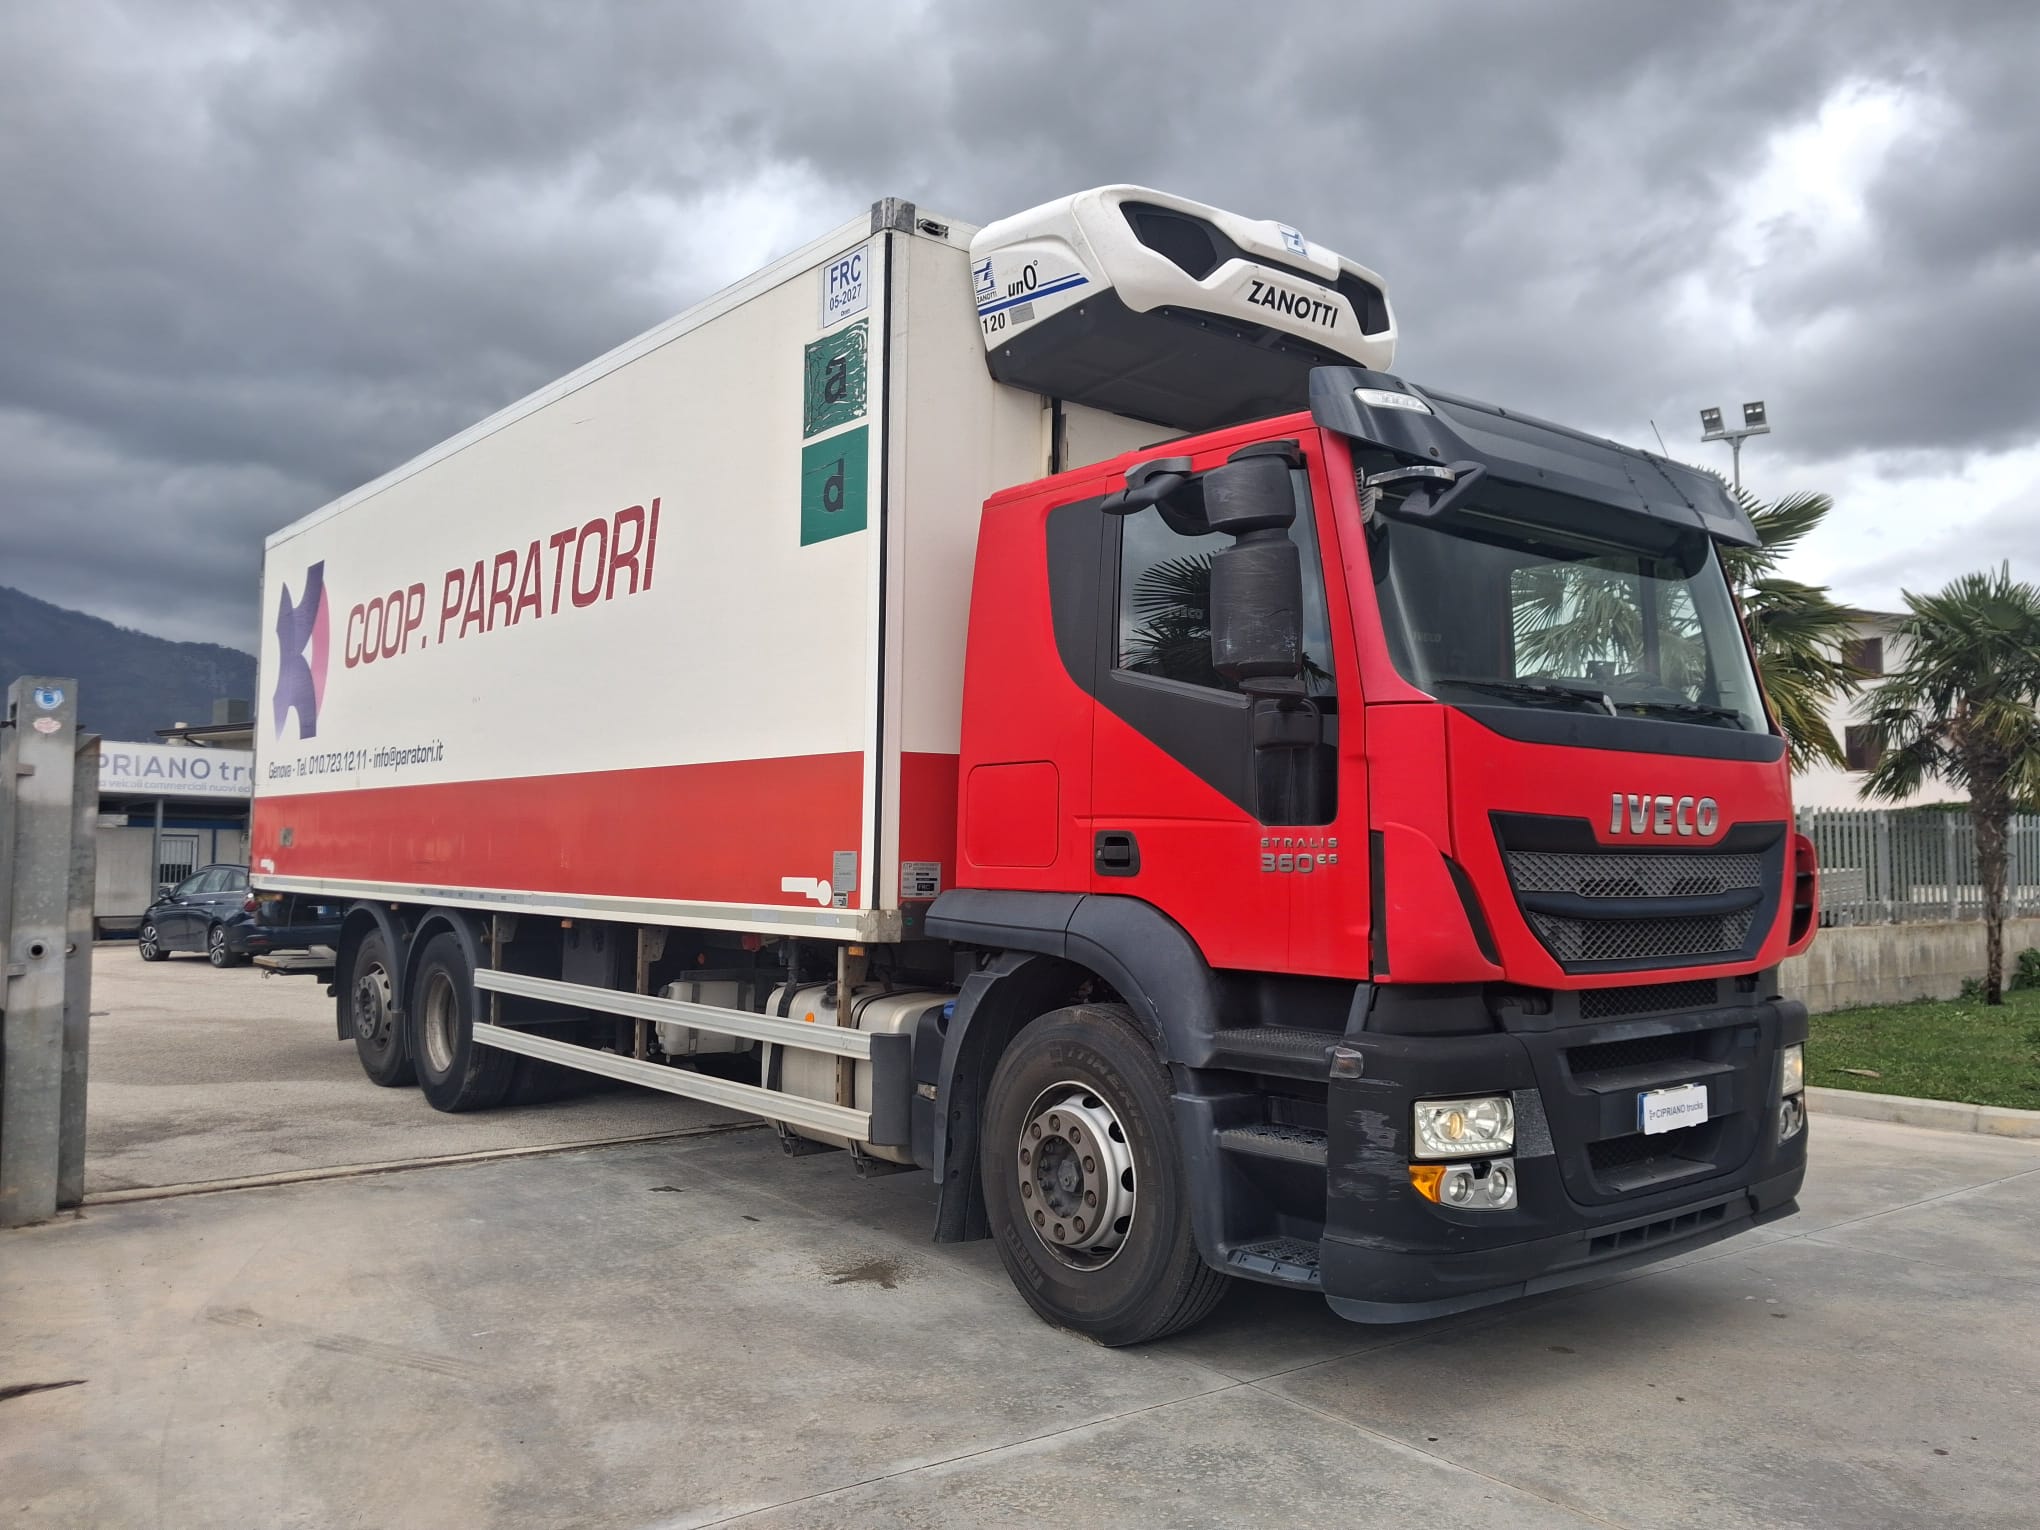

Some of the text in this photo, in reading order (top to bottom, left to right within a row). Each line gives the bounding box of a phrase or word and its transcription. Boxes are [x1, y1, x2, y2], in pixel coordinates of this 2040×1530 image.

[830, 254, 861, 294] FRC
[829, 283, 862, 311] 05-2027
[976, 291, 997, 304] ZANOTTI
[1246, 279, 1339, 329] ZANOTTI
[982, 312, 1006, 335] 120
[823, 457, 845, 513] d
[344, 496, 662, 670] COOP. PARATORI
[268, 761, 292, 779] Genova
[296, 758, 307, 777] Tel.
[308, 749, 368, 775] 010.723.12.11
[373, 739, 444, 772] info@paratori.it
[1609, 793, 1719, 836] IVECO
[1260, 837, 1338, 848] STRALIS
[1655, 1104, 1686, 1119] CIPRIANO
